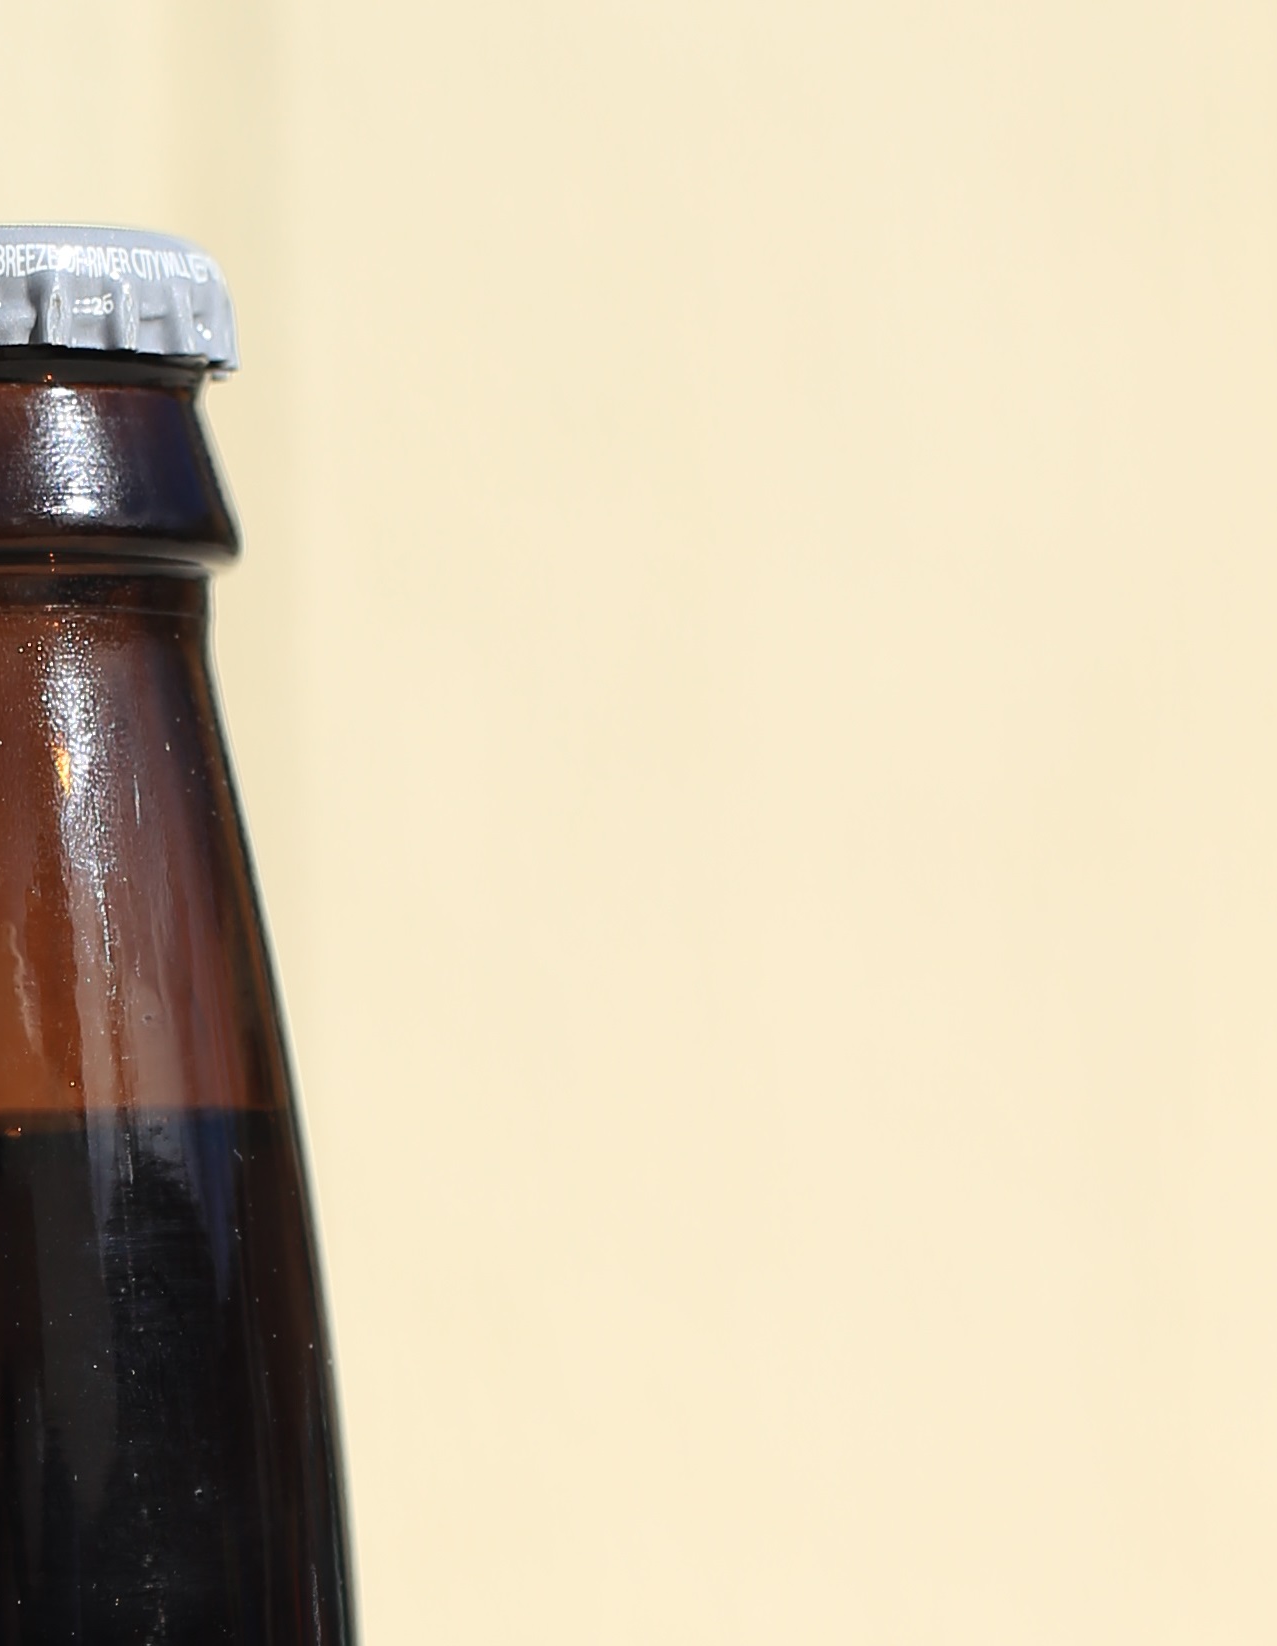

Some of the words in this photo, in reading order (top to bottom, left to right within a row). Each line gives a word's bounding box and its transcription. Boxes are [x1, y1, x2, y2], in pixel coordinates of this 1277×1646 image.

[86, 245, 132, 279] RIVER
[130, 247, 161, 282] CITY
[158, 249, 191, 280] WILL
